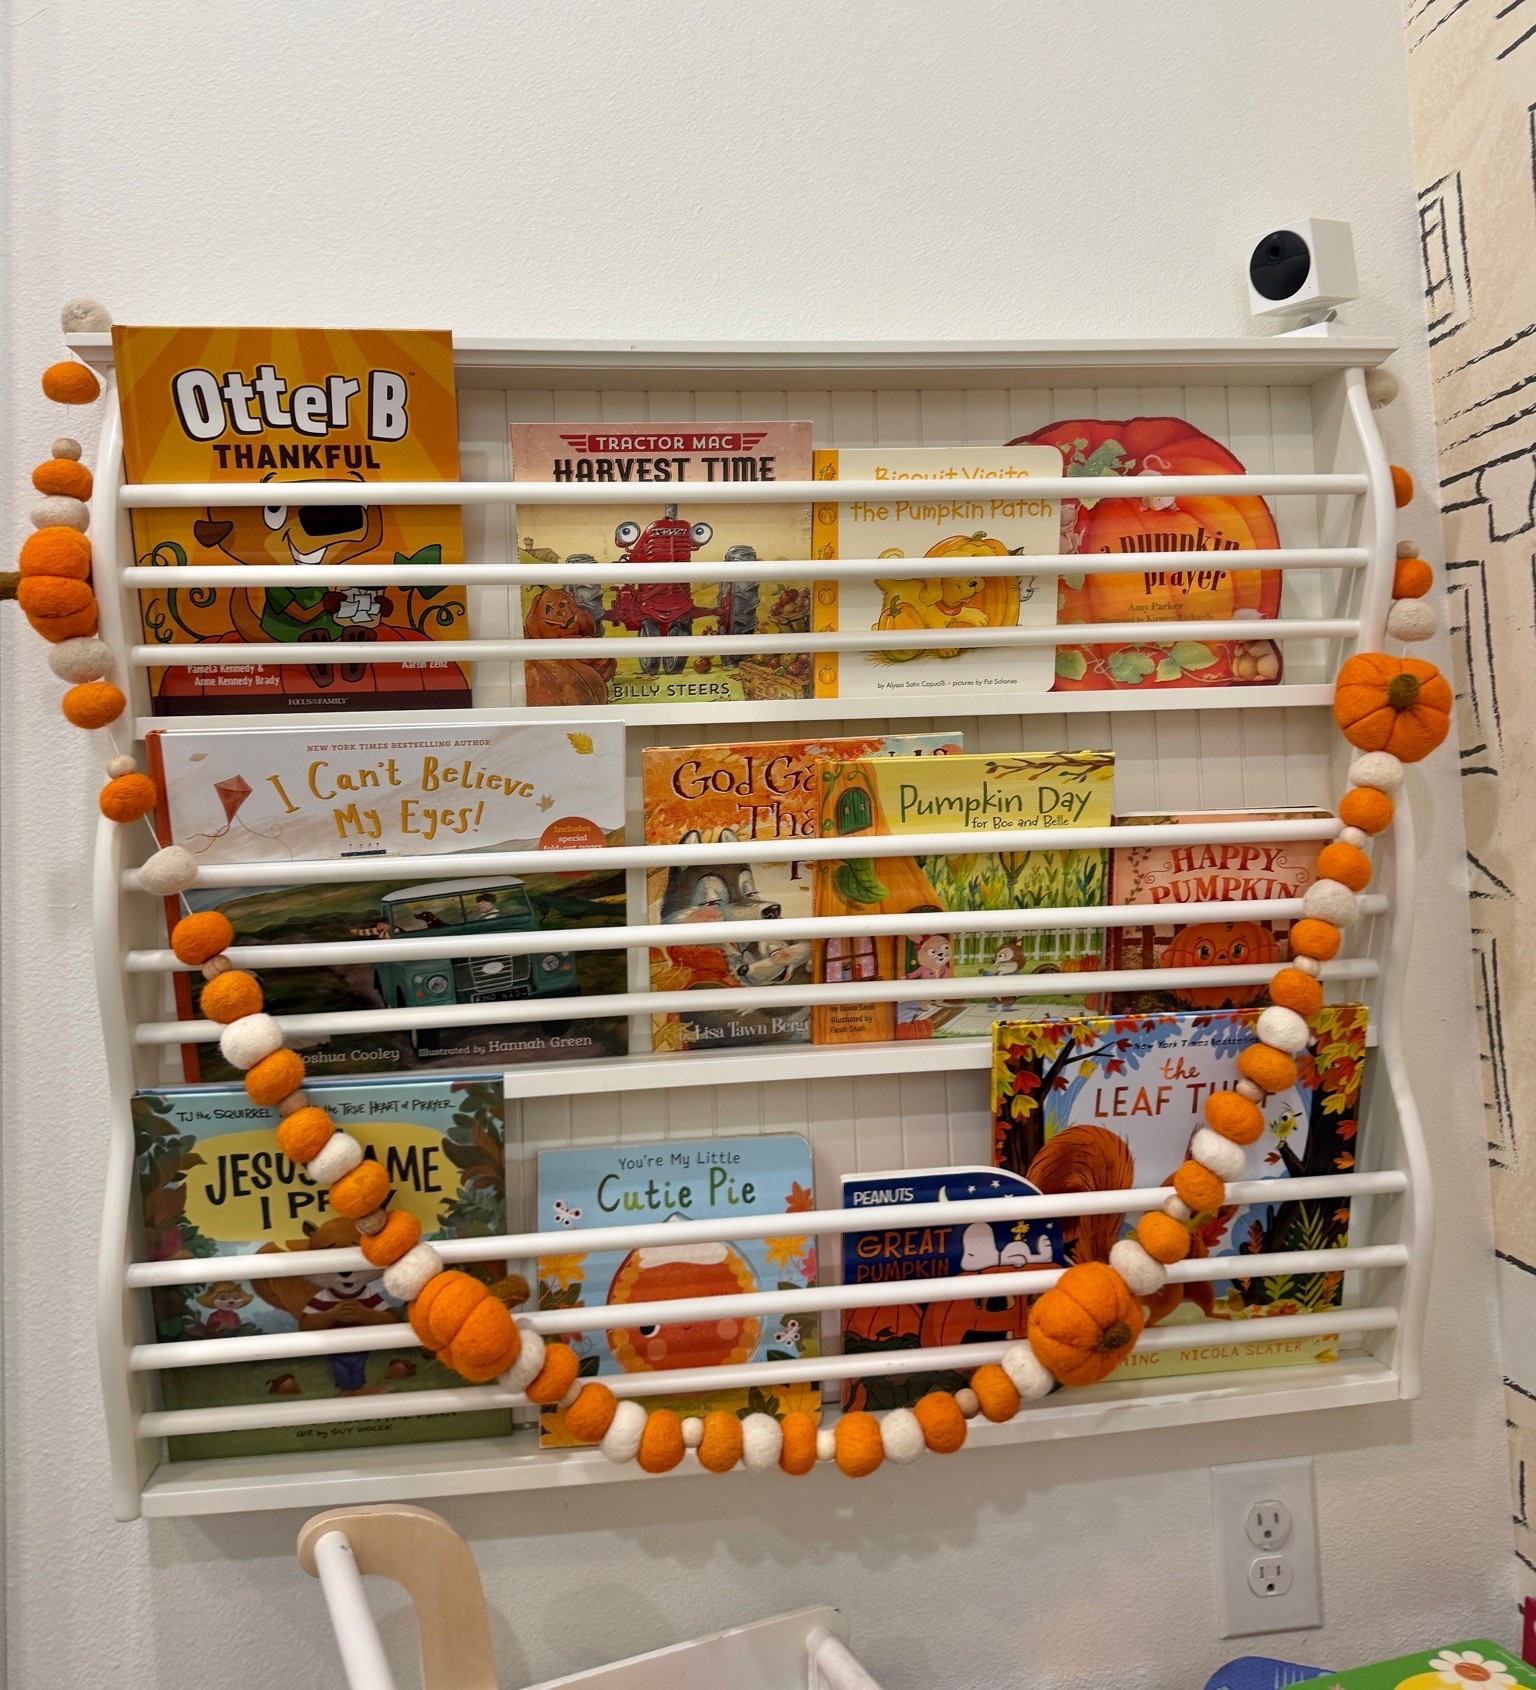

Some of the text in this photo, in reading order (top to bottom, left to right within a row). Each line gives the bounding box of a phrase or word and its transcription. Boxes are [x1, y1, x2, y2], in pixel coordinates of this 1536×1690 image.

[173, 365, 360, 442] Otter
[368, 370, 409, 442] B
[595, 435, 734, 450] TRACTOR MAC
[213, 444, 381, 469] THANKFUL
[553, 456, 777, 483] HARVEST TIME
[851, 498, 1053, 526] the Pumpkin Patch
[1129, 602, 1184, 613] Amy Parker
[187, 664, 218, 673] Pamela
[220, 664, 255, 674] Kennedy
[195, 675, 280, 687] Anne Kennedy Brady
[613, 683, 730, 698] BILLY STEERS
[975, 679, 983, 687] by
[391, 740, 451, 749] BESTSELLING
[454, 739, 491, 747] AUTHOR
[266, 756, 535, 814] I Can't Believe
[672, 756, 754, 800] God
[900, 781, 1092, 827] Pumpkin Day
[333, 799, 485, 841] My Eyes!
[554, 825, 592, 833] Includes
[972, 815, 1070, 829] for Boo and Belle
[558, 834, 588, 844] special
[1169, 844, 1285, 874] HAPPY
[1148, 874, 1301, 905] PUMPKIN
[831, 1014, 872, 1023] Illustrated by
[695, 1024, 724, 1040] Lisa
[728, 1021, 768, 1037] Tawn
[418, 1036, 593, 1058] Illustrated by Hannah Green
[1133, 1037, 1260, 1050] New York Times bestseer
[300, 1048, 400, 1064] oshua Cooley
[1159, 1056, 1200, 1080] the
[339, 1102, 366, 1115] TRUE
[369, 1100, 399, 1114] HEART
[412, 1098, 456, 1111] PRAYER
[1094, 1085, 1173, 1118] LEAF
[176, 1111, 194, 1122] TJ
[196, 1110, 212, 1120] the
[215, 1107, 273, 1119] SQUIRREL
[618, 1151, 741, 1171] You're My Little
[597, 1167, 756, 1213] Cutie Pie
[853, 1187, 914, 1206] PEANUTS
[260, 1196, 272, 1231] I
[856, 1227, 953, 1260] GREAT
[856, 1258, 949, 1283] PUMPKIN
[1120, 1341, 1303, 1366] MING NICOLA SLATER
[331, 1427, 354, 1435] GUY
